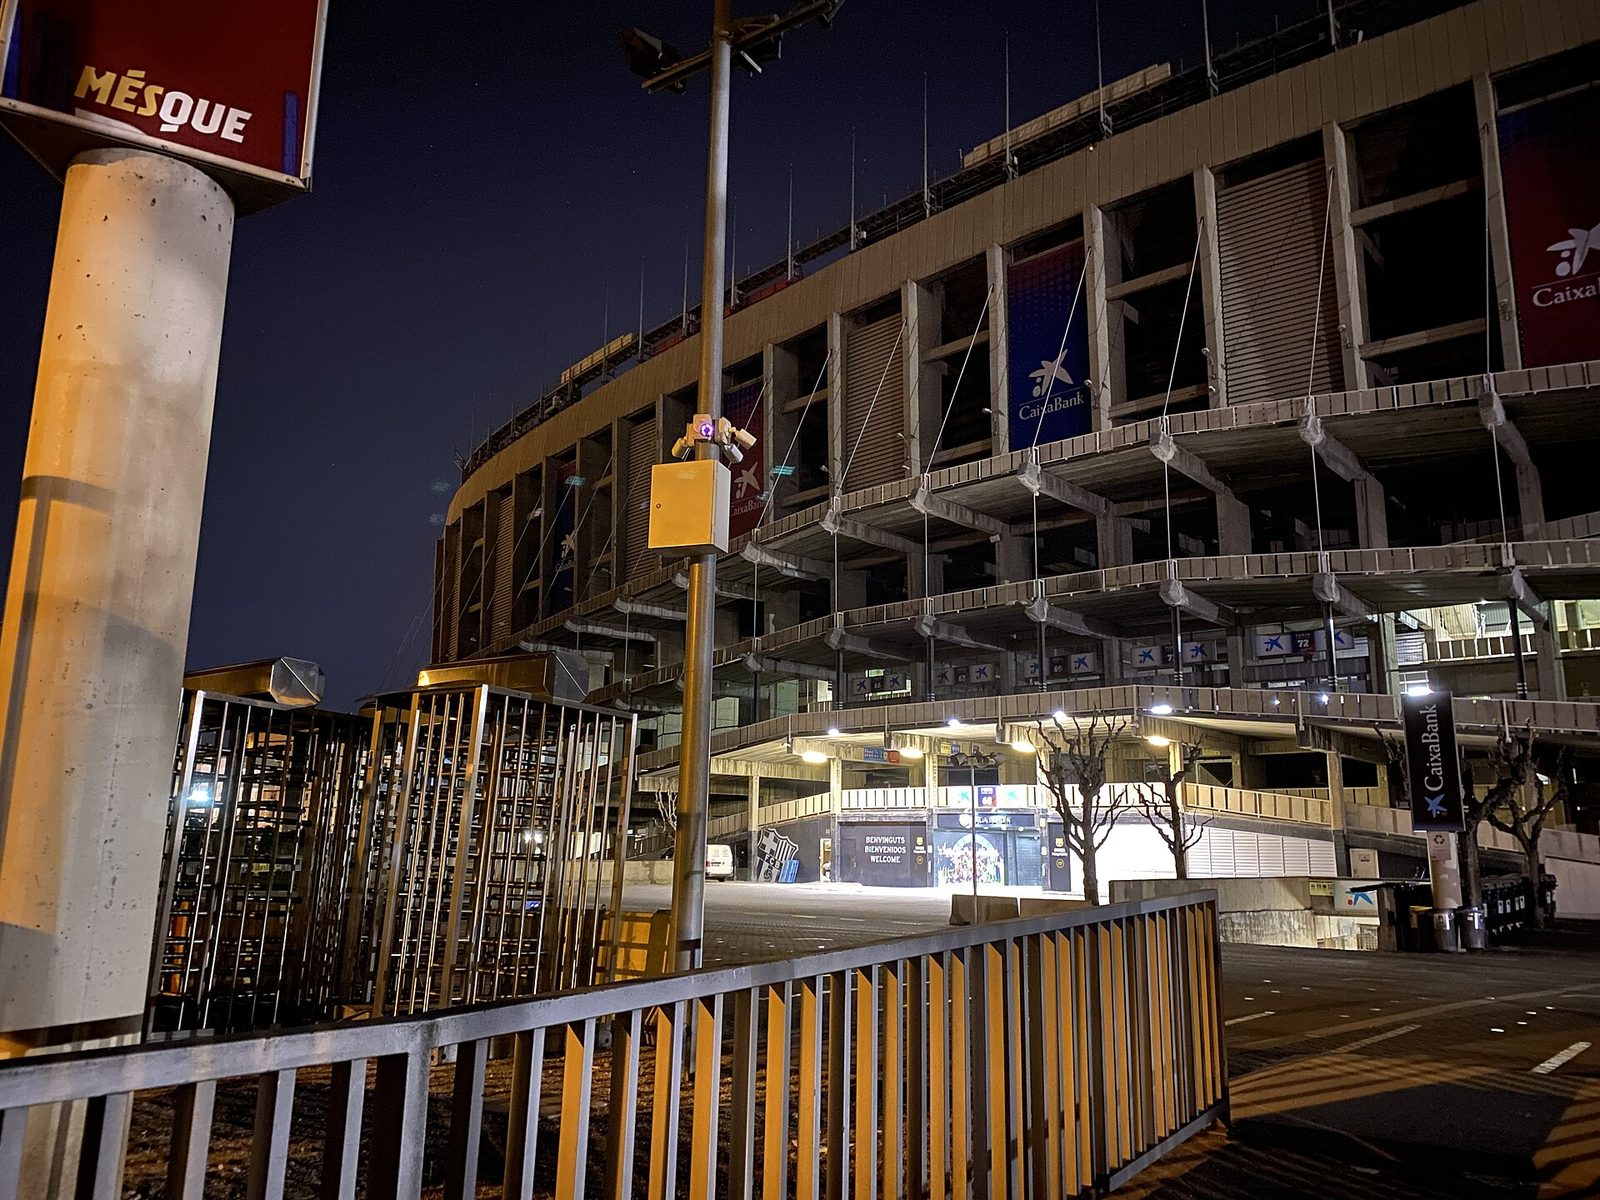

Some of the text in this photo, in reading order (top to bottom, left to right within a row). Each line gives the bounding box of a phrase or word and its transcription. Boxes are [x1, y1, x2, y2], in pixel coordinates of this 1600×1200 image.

[1532, 277, 1600, 307] Caixa
[1297, 639, 1310, 648] 72
[1419, 703, 1444, 792] CaixaBank
[865, 836, 906, 844] BENVINGUTS
[864, 845, 907, 854] BIENVENIDOS
[870, 855, 901, 864] WELCOME
